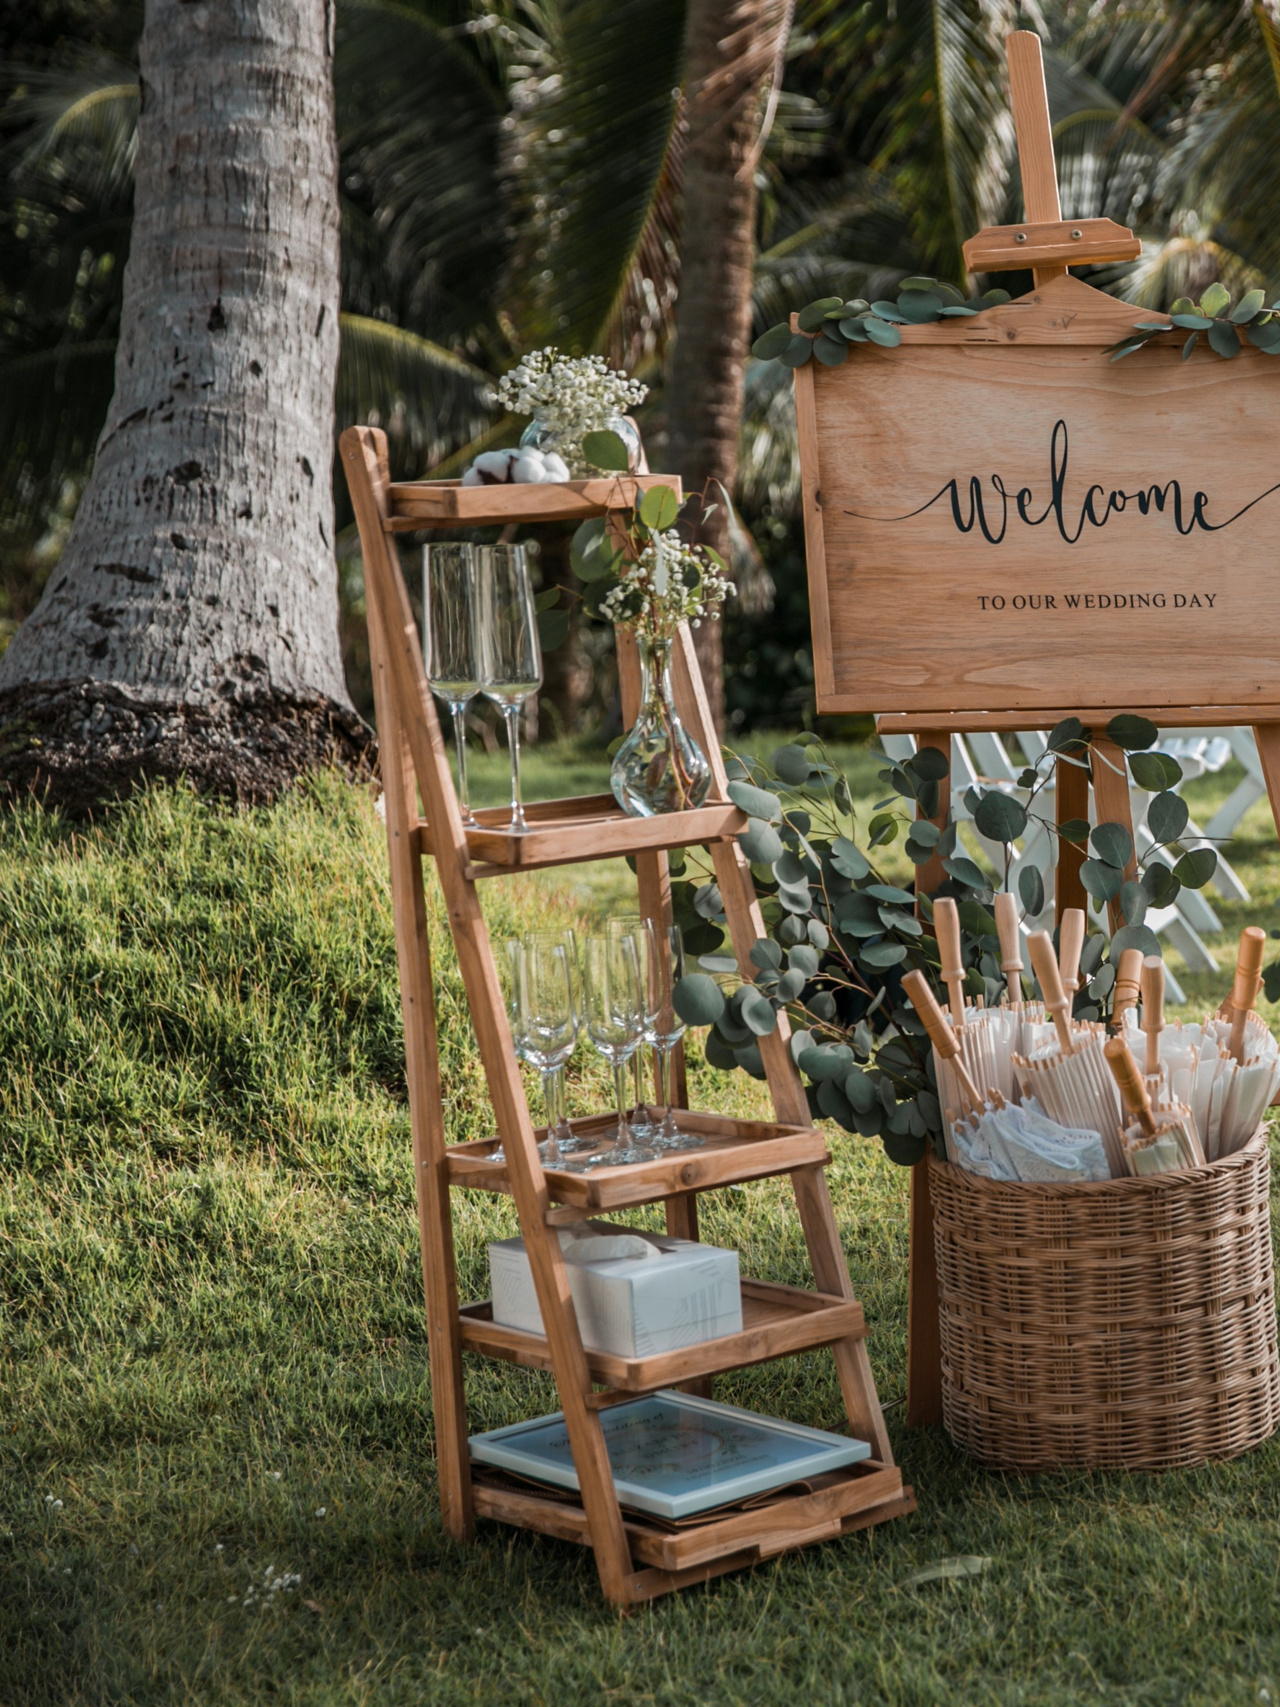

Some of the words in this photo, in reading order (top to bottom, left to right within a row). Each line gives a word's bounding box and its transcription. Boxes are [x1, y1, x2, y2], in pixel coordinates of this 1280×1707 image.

[976, 595, 1006, 611] TO
[1012, 594, 1058, 610] OUR
[1063, 593, 1167, 609] WEDDING
[1173, 593, 1217, 608] DAY
